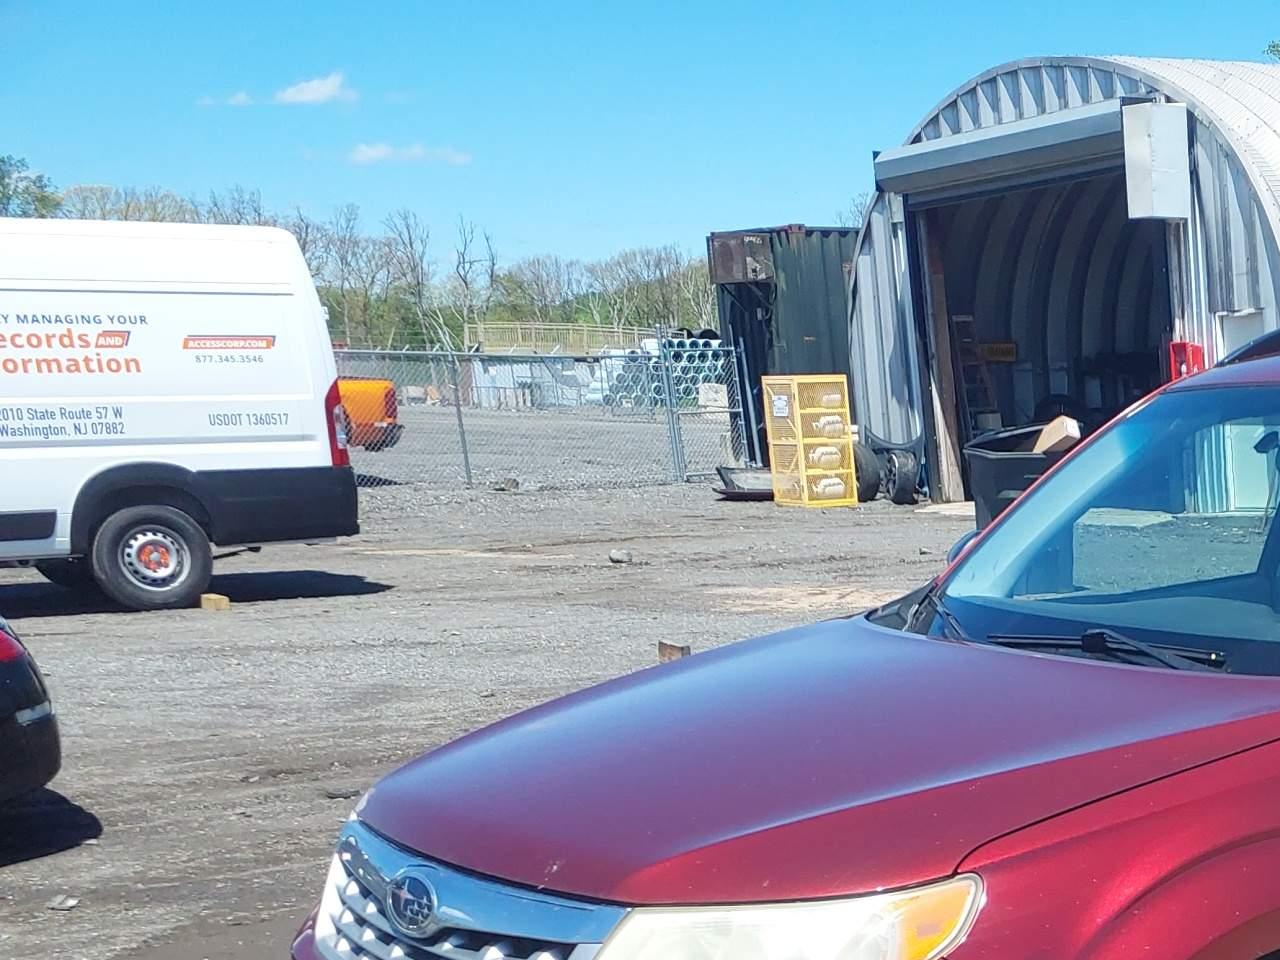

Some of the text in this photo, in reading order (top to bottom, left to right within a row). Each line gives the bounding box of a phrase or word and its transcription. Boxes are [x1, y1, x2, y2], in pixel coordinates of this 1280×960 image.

[0, 314, 148, 325] Y MANAGING YOUR
[97, 336, 123, 346] AND
[188, 339, 268, 349] ACCESSCORP.COM
[2, 353, 142, 374] ormation
[195, 354, 264, 363] 877.345.3546
[26, 407, 57, 421] State
[60, 406, 93, 420] Route
[96, 406, 109, 419] 57
[112, 406, 123, 419] W
[208, 413, 289, 426] USDOT 1360517
[0, 422, 125, 440] Washington, NJ 07882
